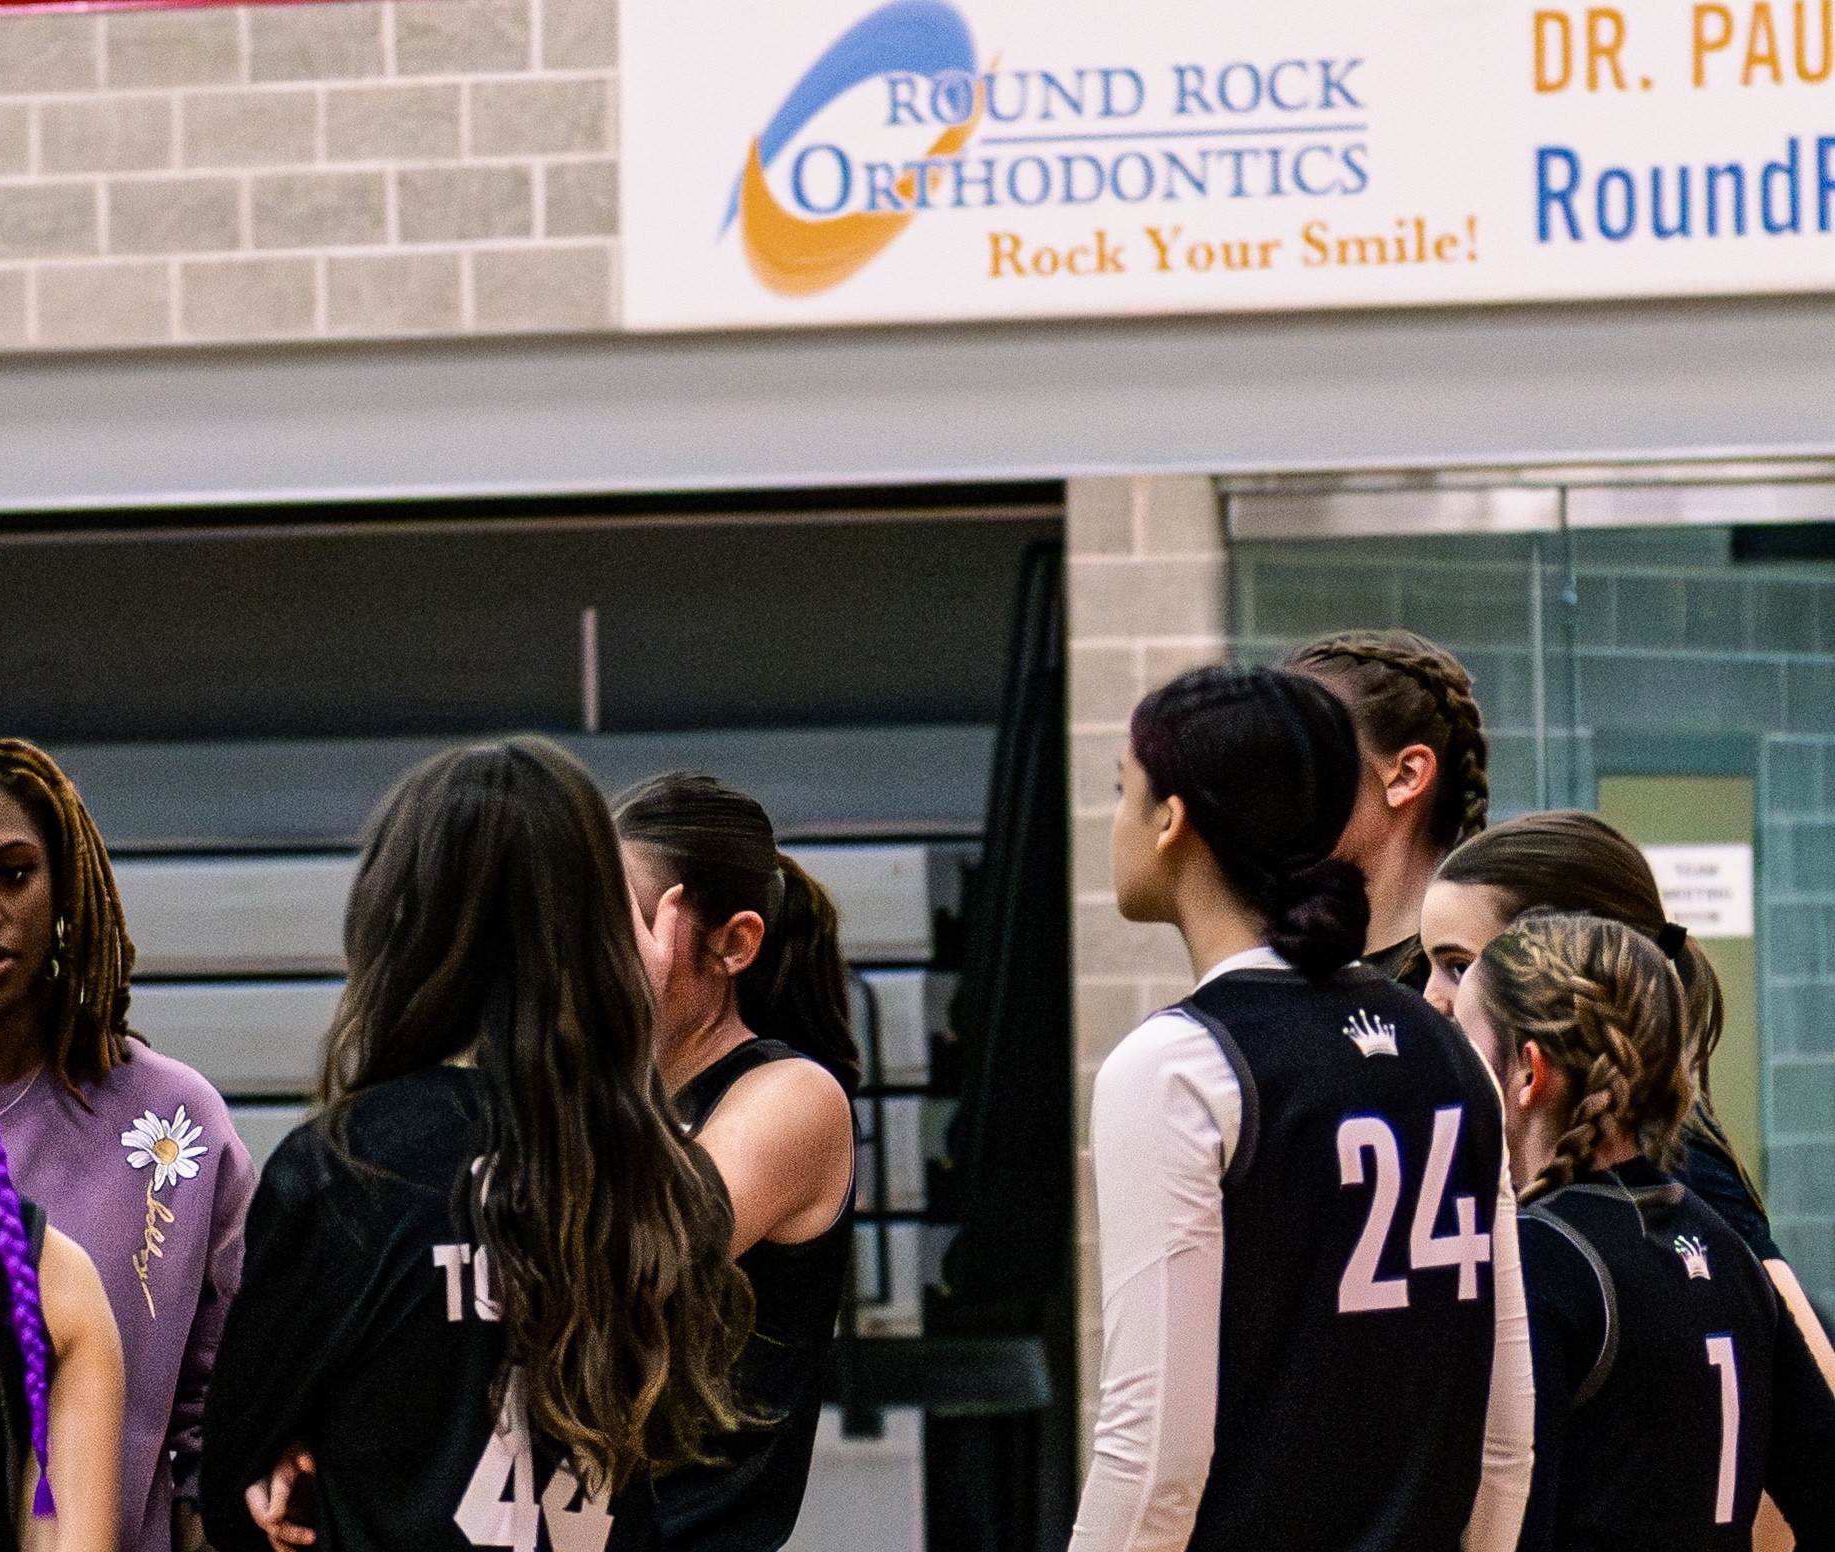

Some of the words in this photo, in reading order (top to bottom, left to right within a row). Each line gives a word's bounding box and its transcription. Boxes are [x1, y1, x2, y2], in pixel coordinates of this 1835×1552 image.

[1532, 7, 1653, 93] DR.
[884, 67, 1145, 127] ROUND
[1171, 58, 1367, 118] ROCK
[790, 141, 1369, 214] ORTHODONTICS
[988, 228, 1126, 279] Rock
[1143, 225, 1282, 274] Your
[1300, 215, 1480, 268] Smile!
[1336, 1105, 1491, 1314] 24
[1705, 1335, 1740, 1524] 1
